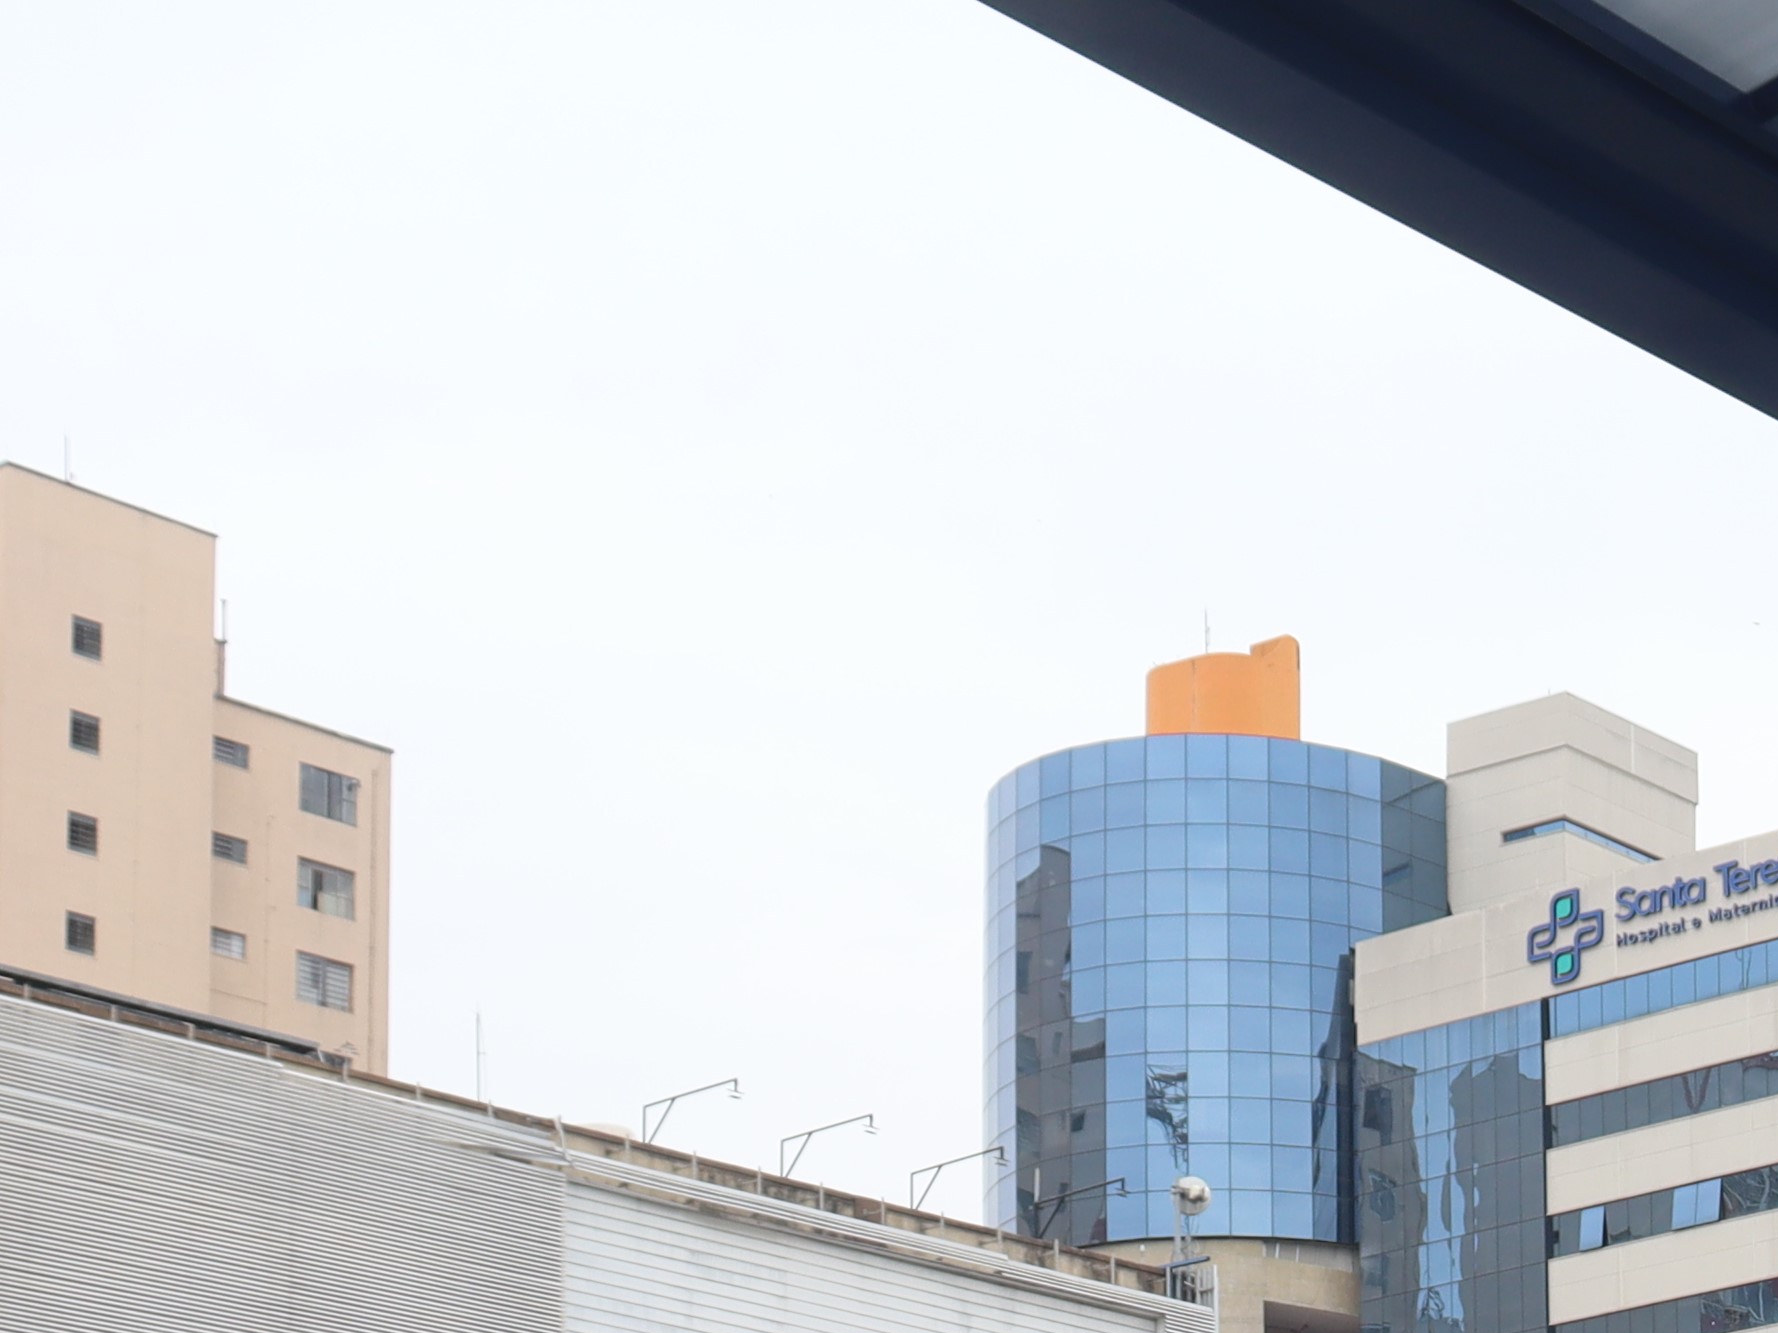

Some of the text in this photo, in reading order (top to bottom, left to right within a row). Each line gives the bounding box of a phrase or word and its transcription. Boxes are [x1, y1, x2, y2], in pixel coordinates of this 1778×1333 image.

[1615, 876, 1707, 922] Santa
[1616, 917, 1688, 948] Hospital
[1692, 918, 1702, 930] e
